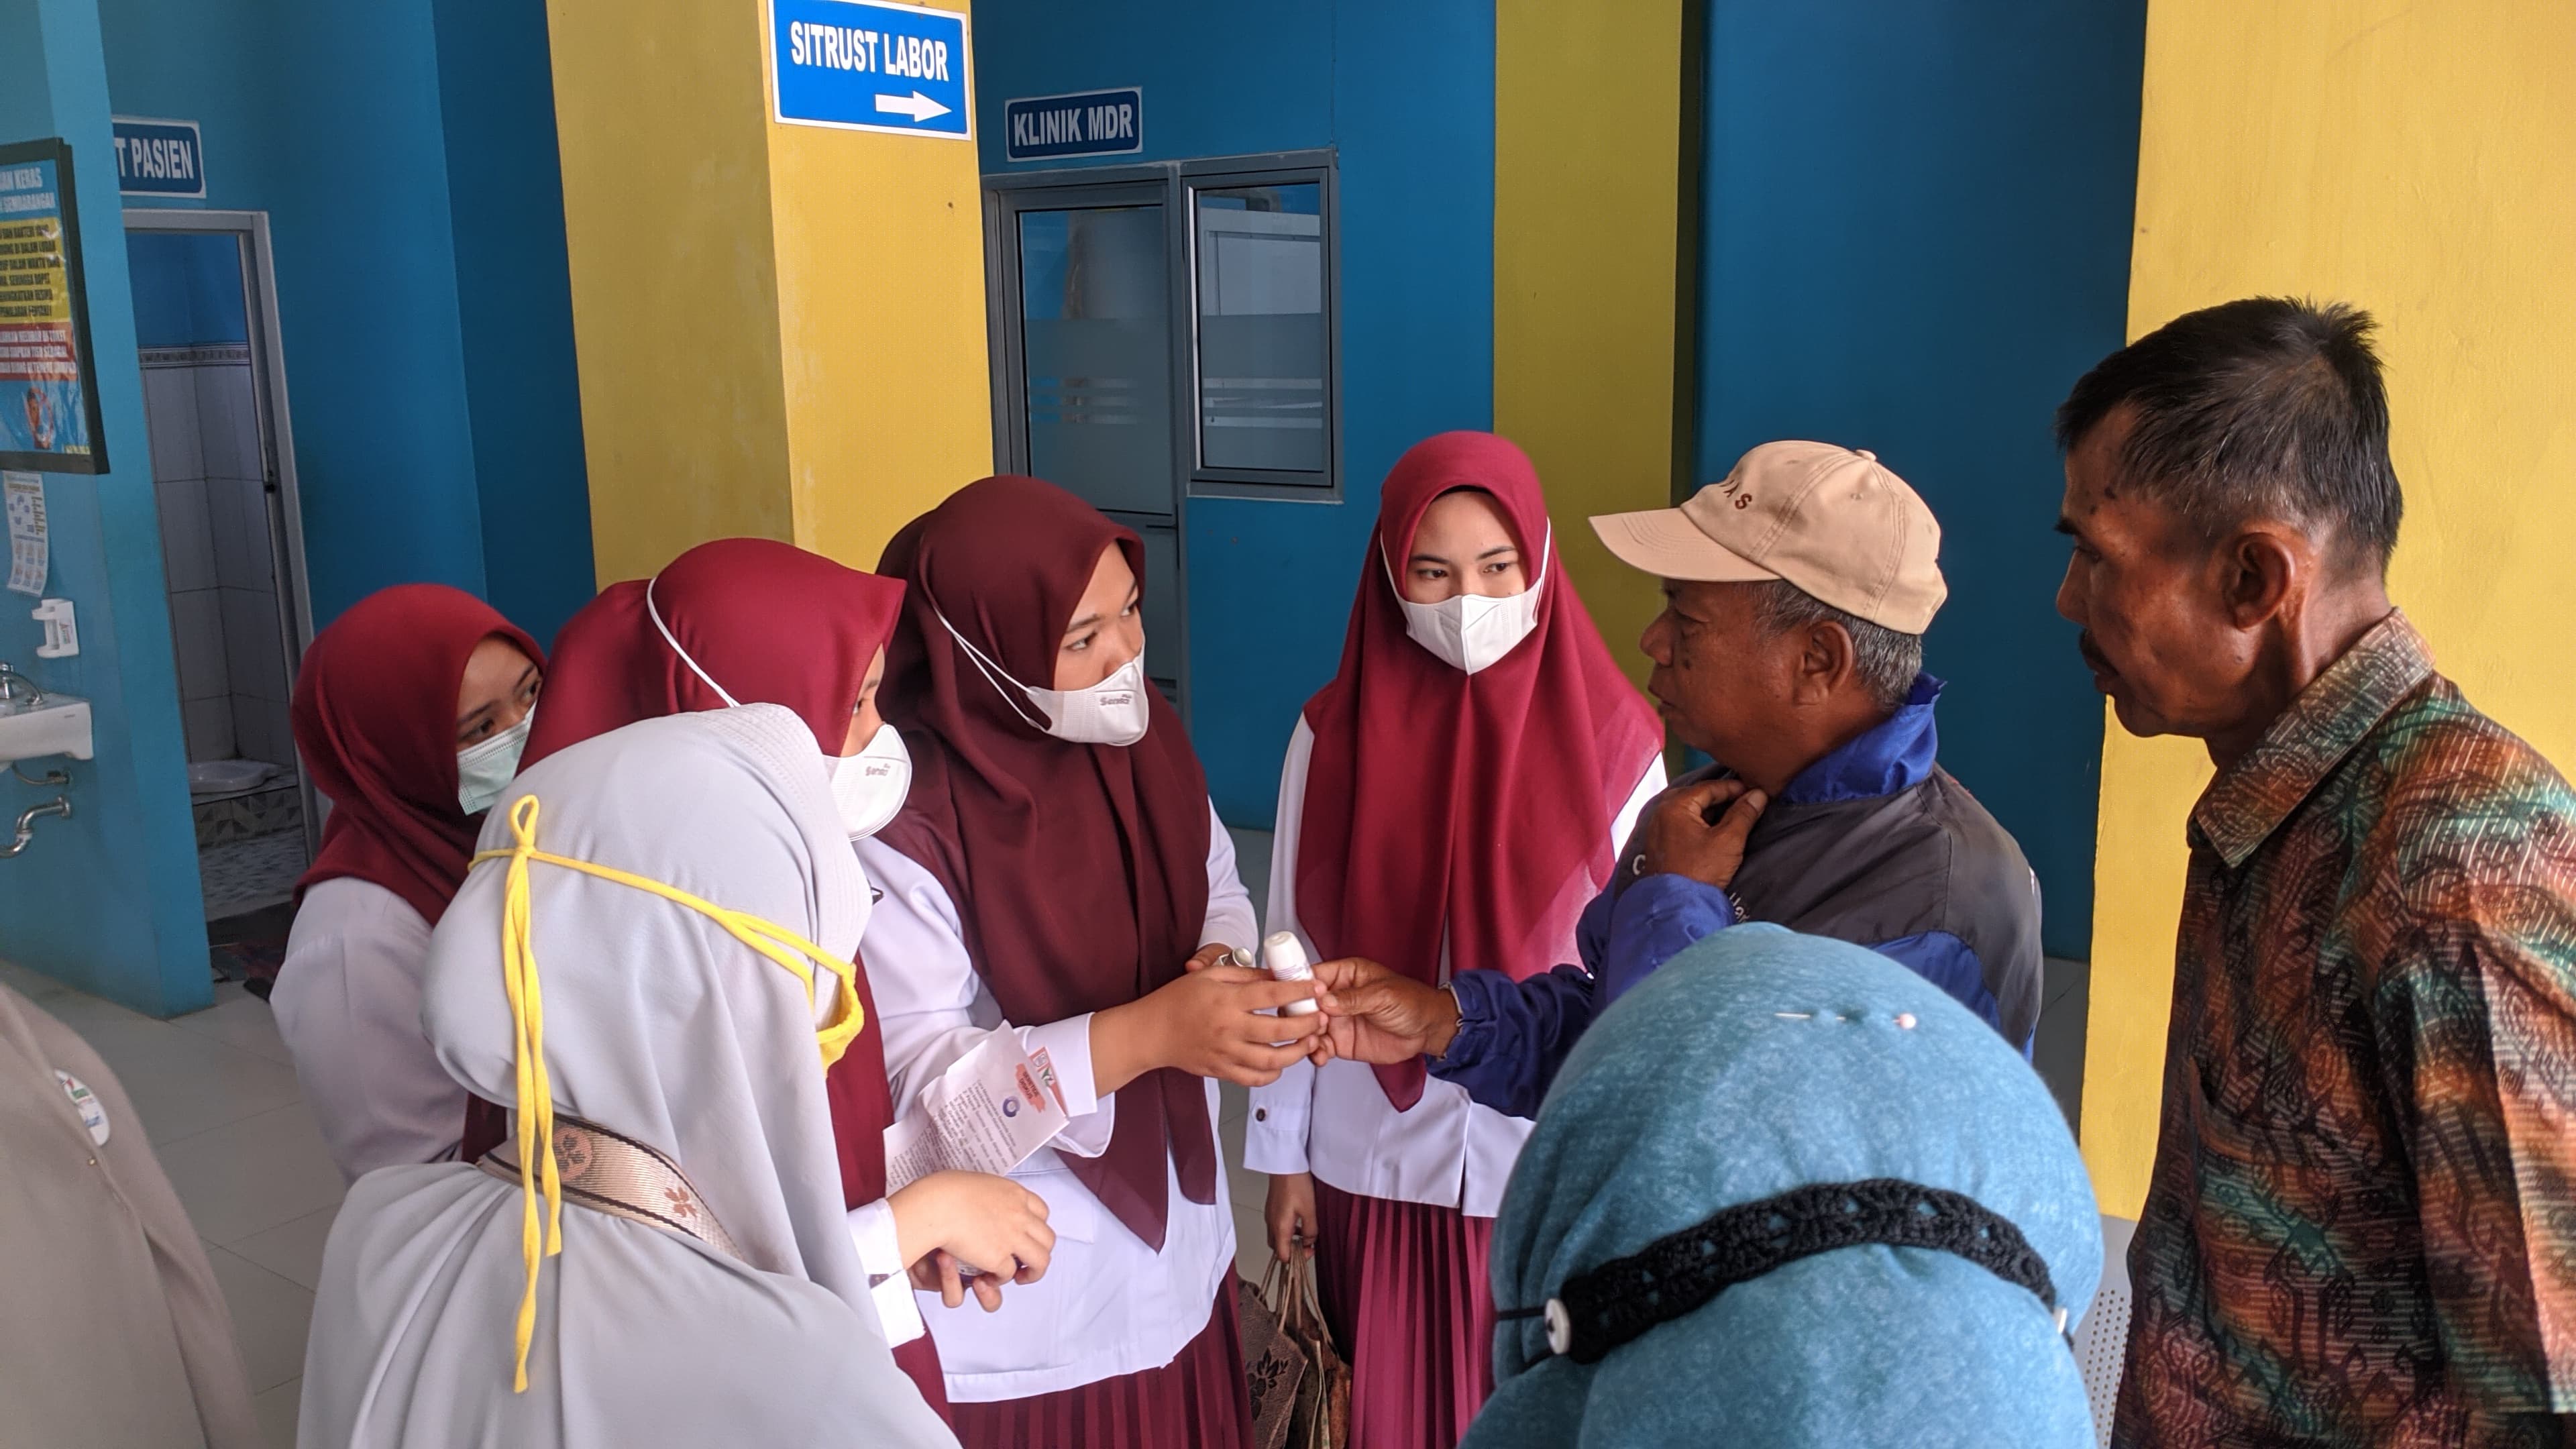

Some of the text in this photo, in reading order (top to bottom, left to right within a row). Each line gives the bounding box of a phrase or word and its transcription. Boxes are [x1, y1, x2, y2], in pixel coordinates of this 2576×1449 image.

[790, 21, 950, 82] SITRUST LABOR
[1014, 104, 1133, 148] KLINIK MDR
[14, 167, 43, 190] KERAS
[130, 138, 195, 180] PASIEN
